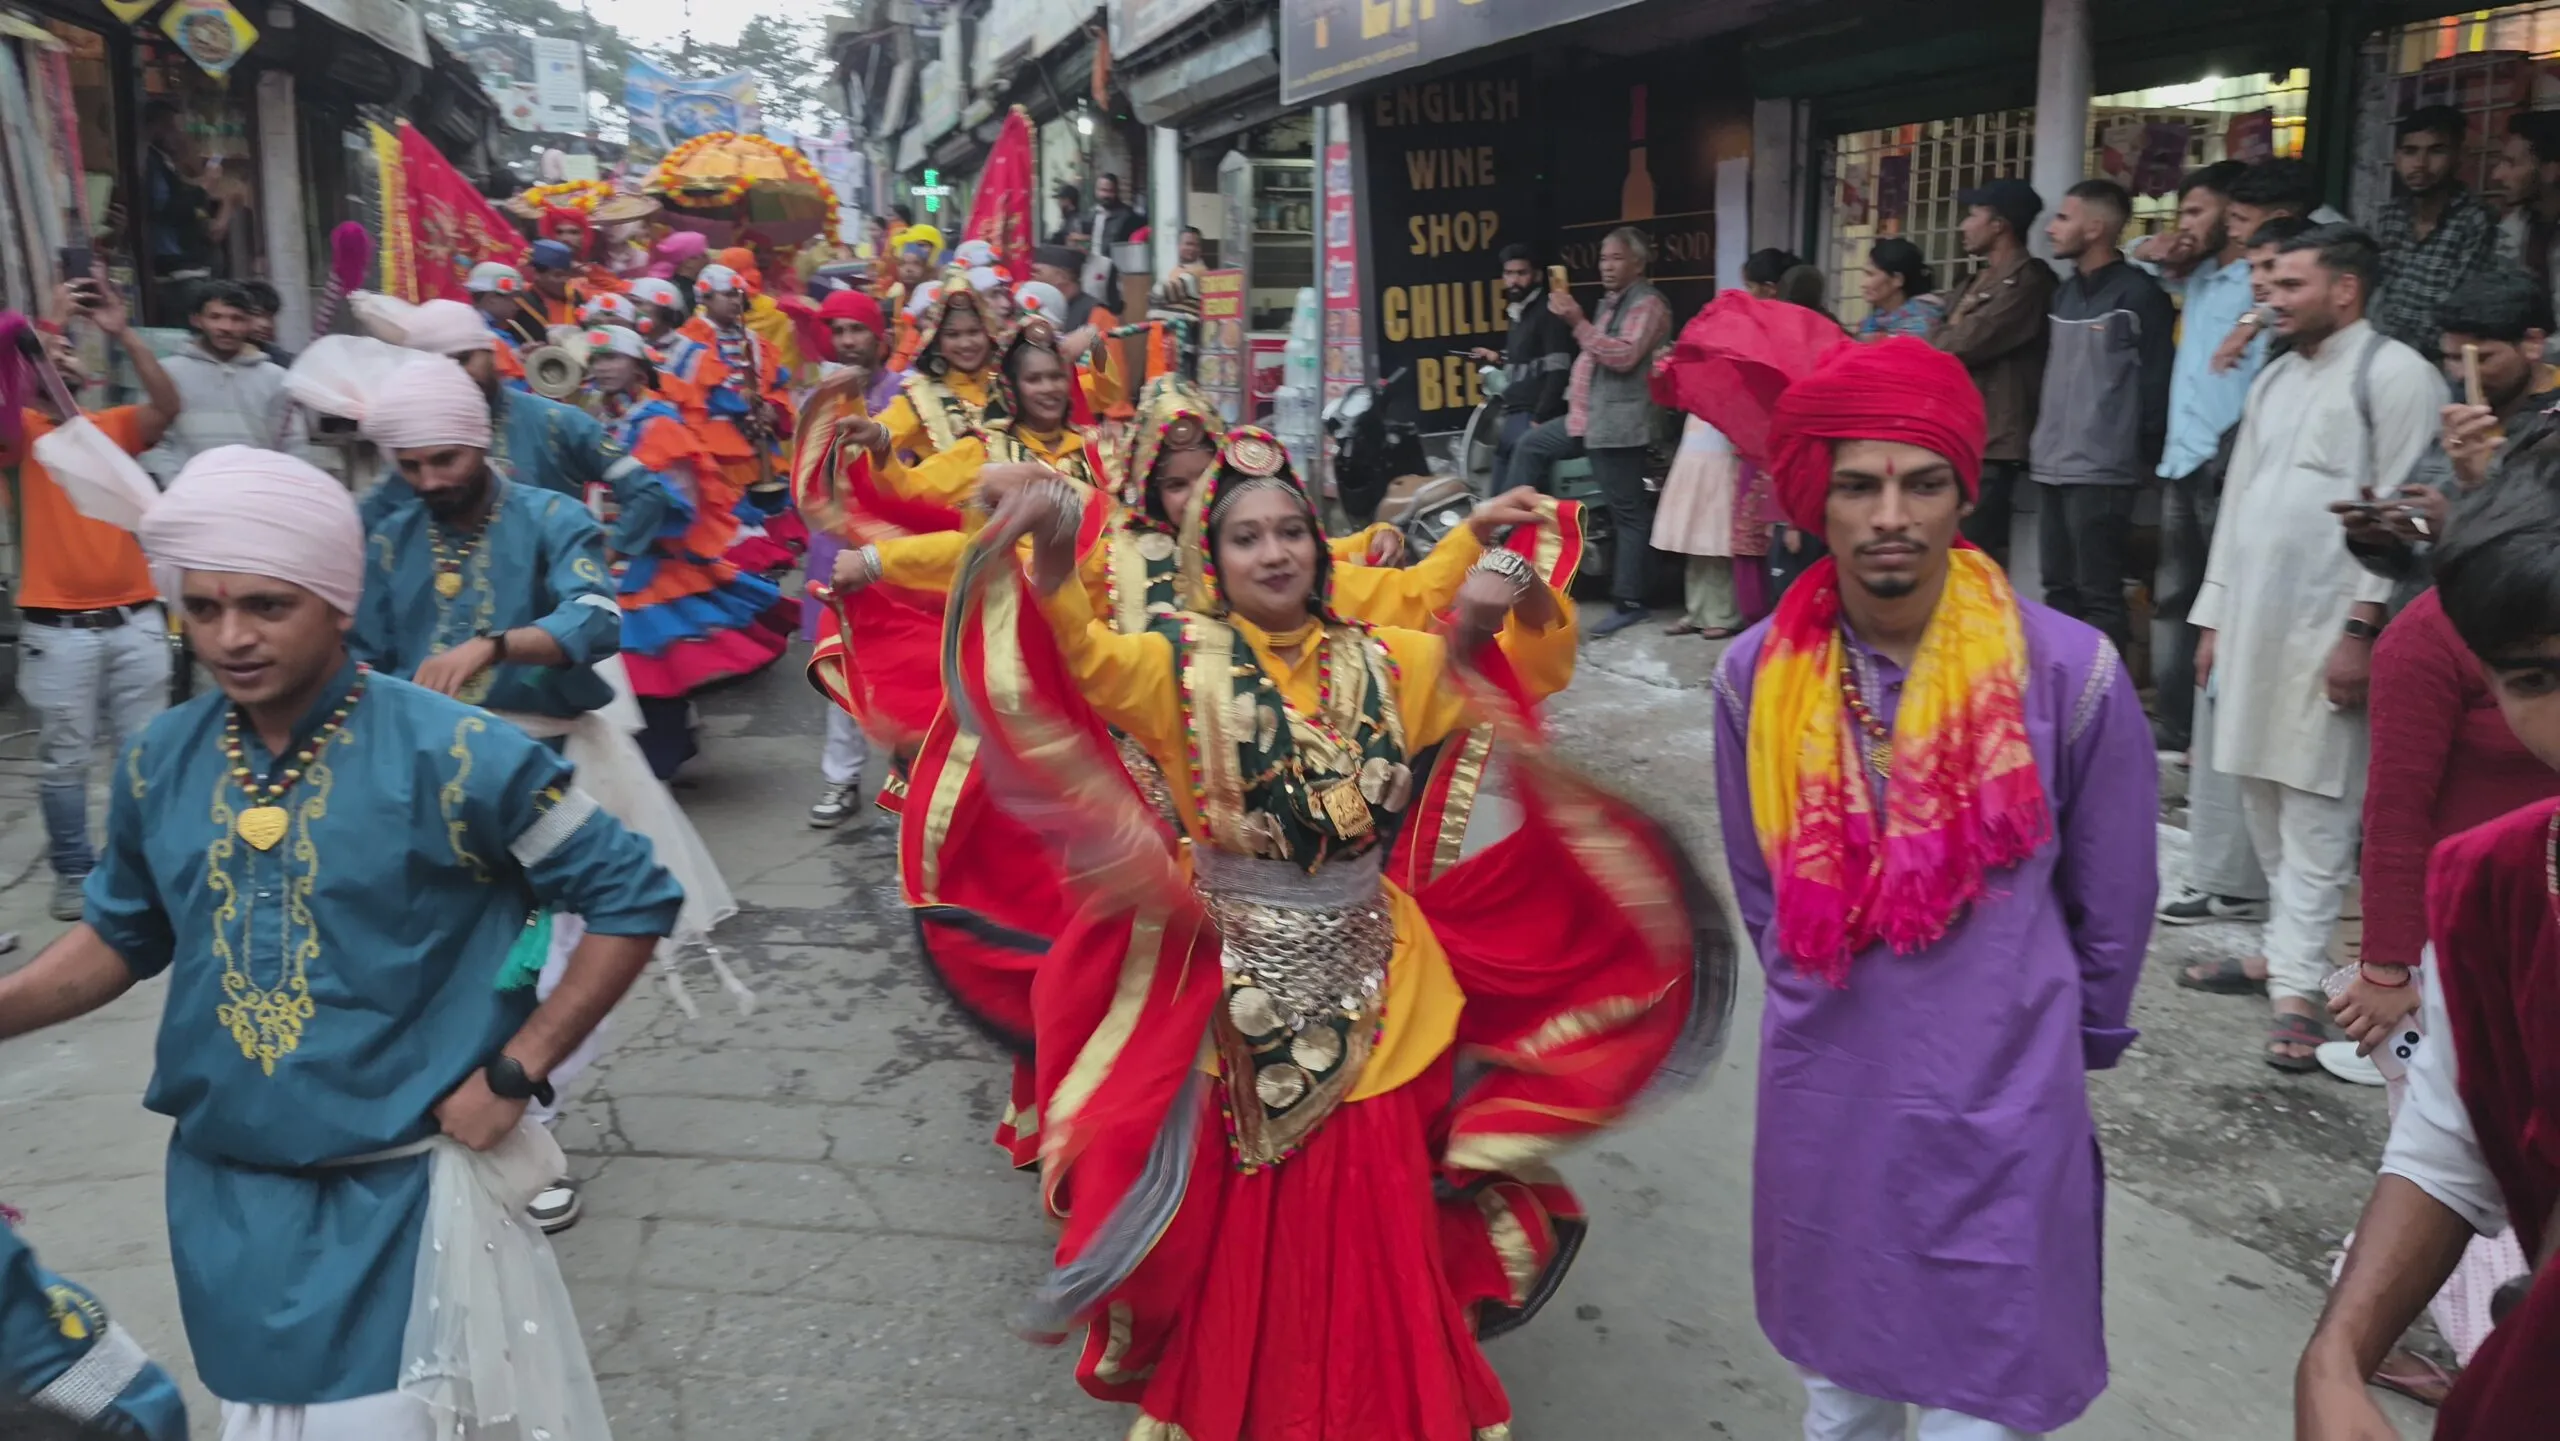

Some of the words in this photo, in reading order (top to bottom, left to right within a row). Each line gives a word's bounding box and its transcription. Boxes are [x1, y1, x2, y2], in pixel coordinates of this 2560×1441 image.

[1375, 79, 1519, 126] ENGLISH
[1405, 146, 1496, 190] WINE
[1409, 210, 1500, 257] SHOP
[1664, 231, 1712, 262] SOD
[1383, 279, 1510, 342] CHILLE
[1416, 355, 1487, 411] BEE
